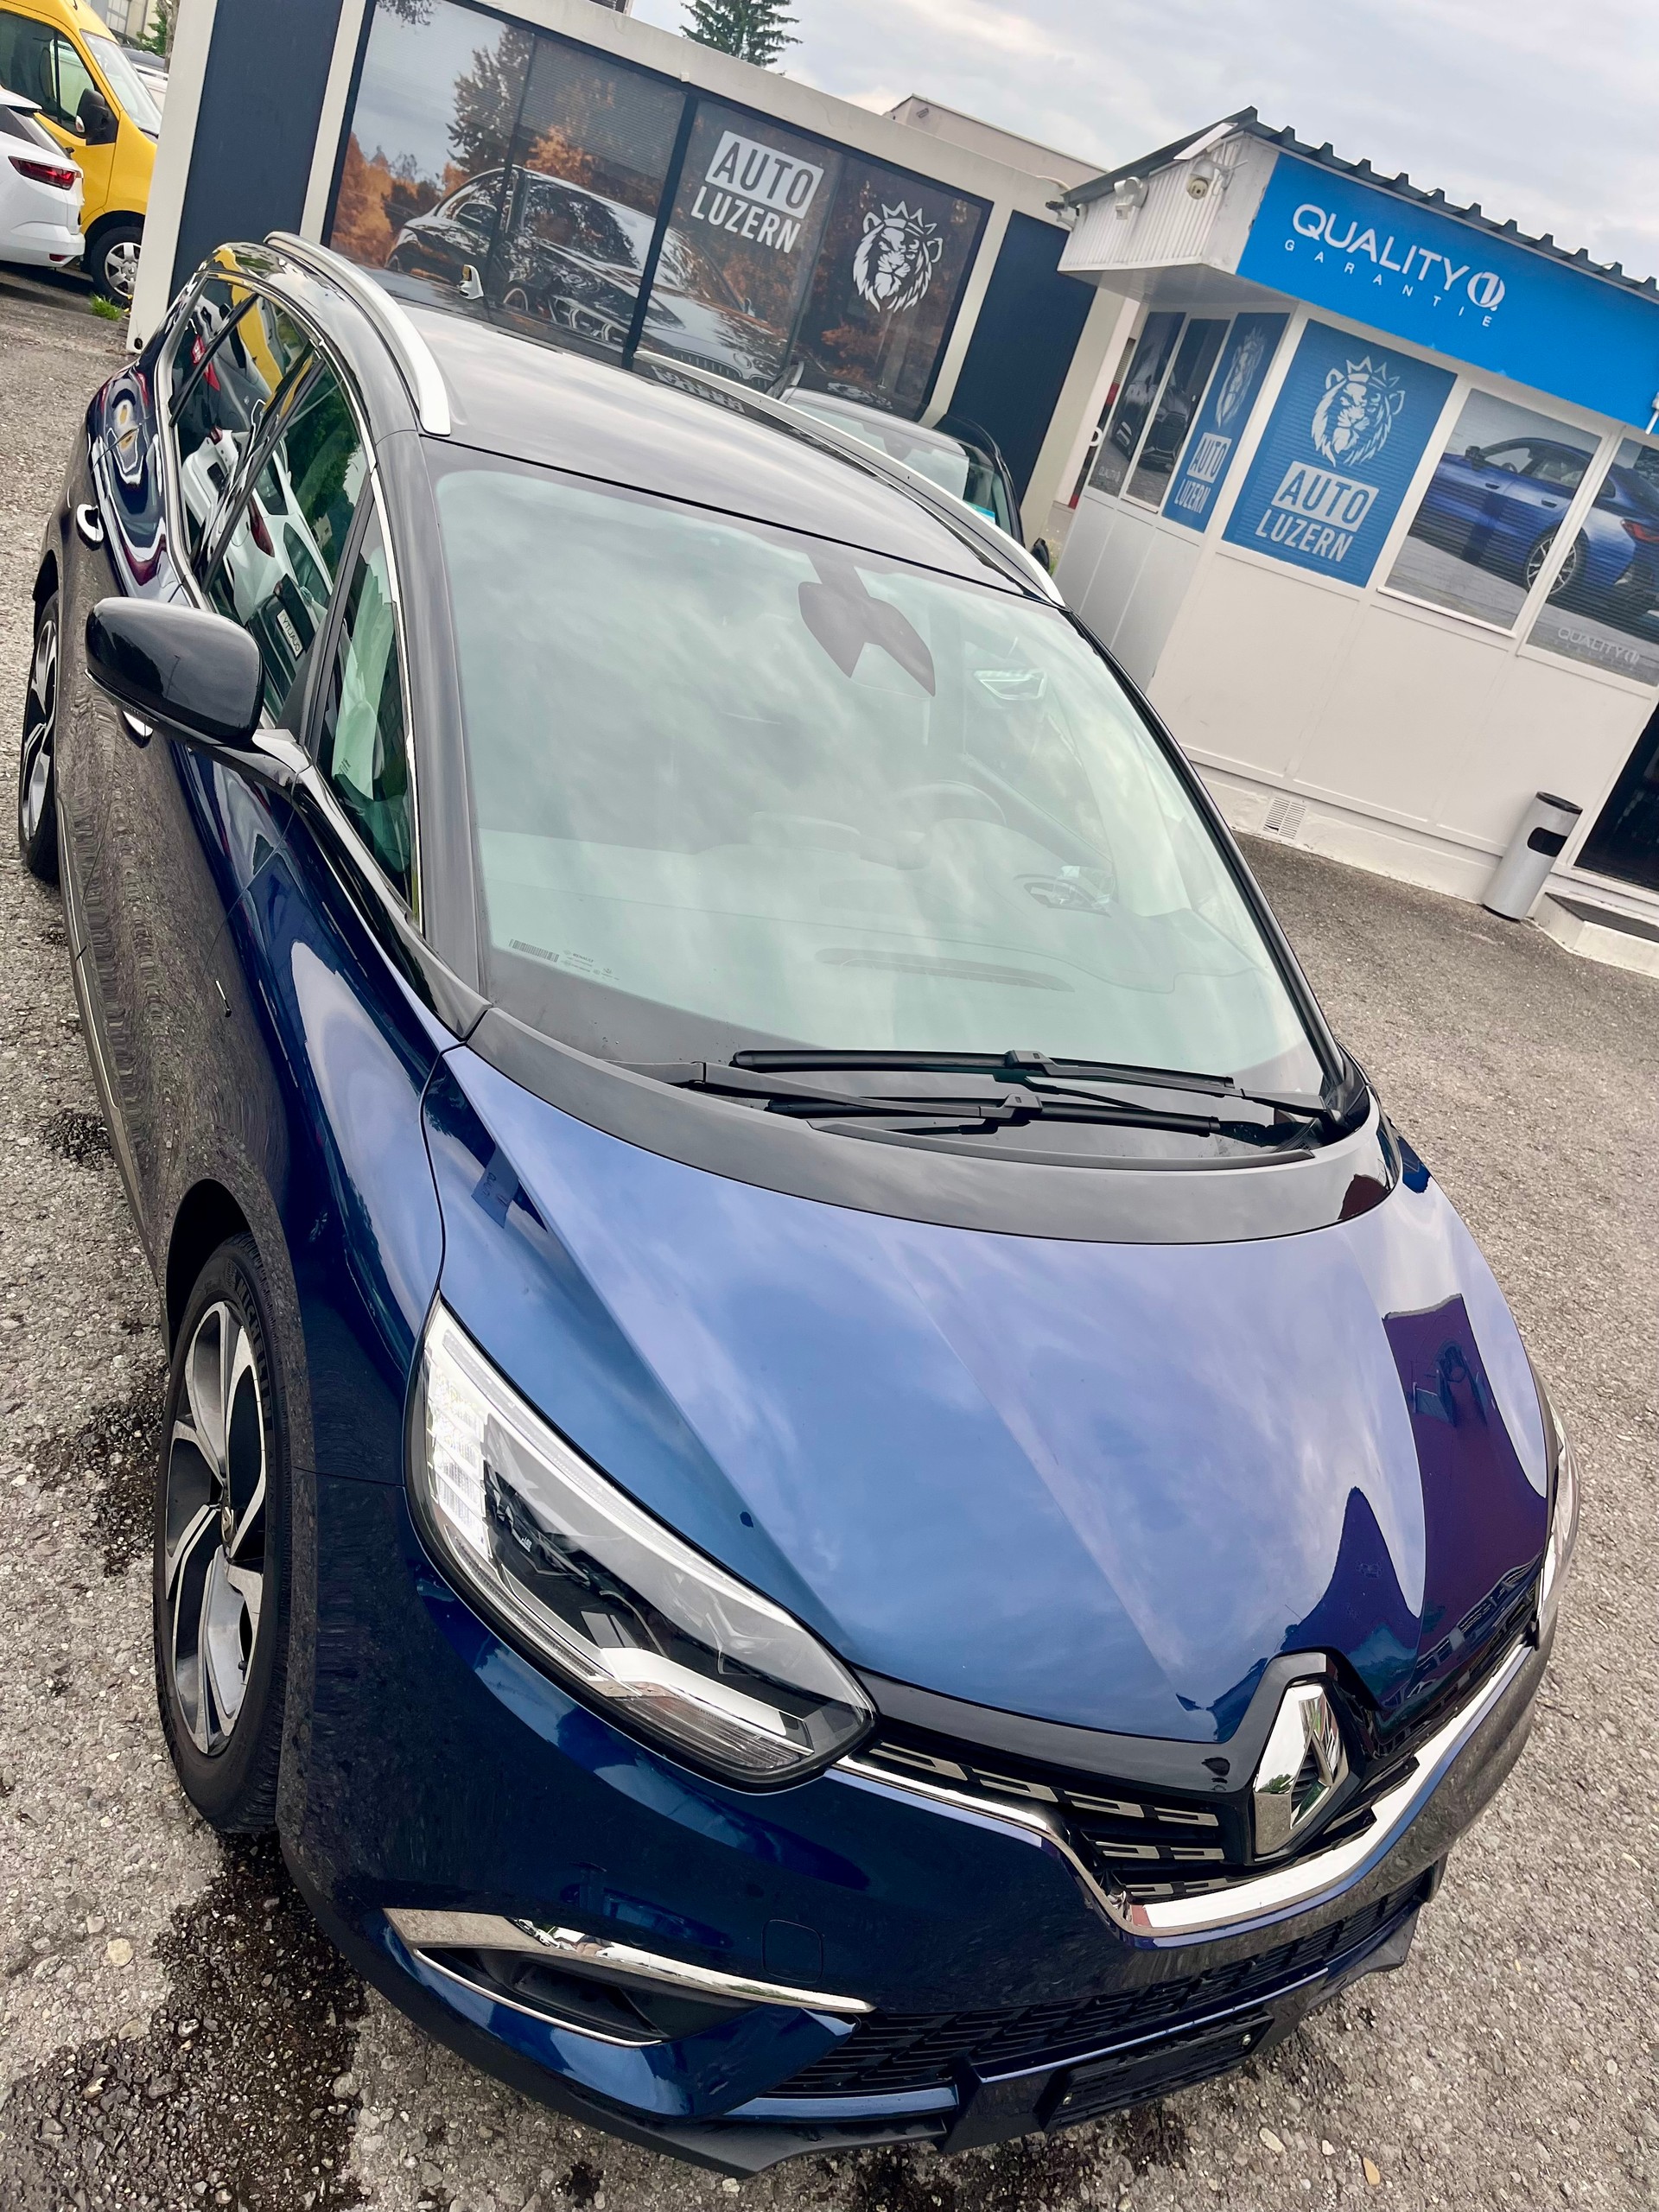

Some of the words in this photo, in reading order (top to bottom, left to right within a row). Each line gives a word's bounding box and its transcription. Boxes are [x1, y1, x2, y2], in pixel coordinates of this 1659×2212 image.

[711, 141, 814, 210] AUTO
[690, 185, 802, 254] LUZERN
[1284, 238, 1493, 327] GARANTIE
[1189, 437, 1229, 478] AUTO
[1173, 478, 1211, 514] LUZERN
[1277, 469, 1370, 524] AUTO
[1255, 508, 1354, 563] LUZERN
[235, 1277, 273, 1419] MICHELIN
